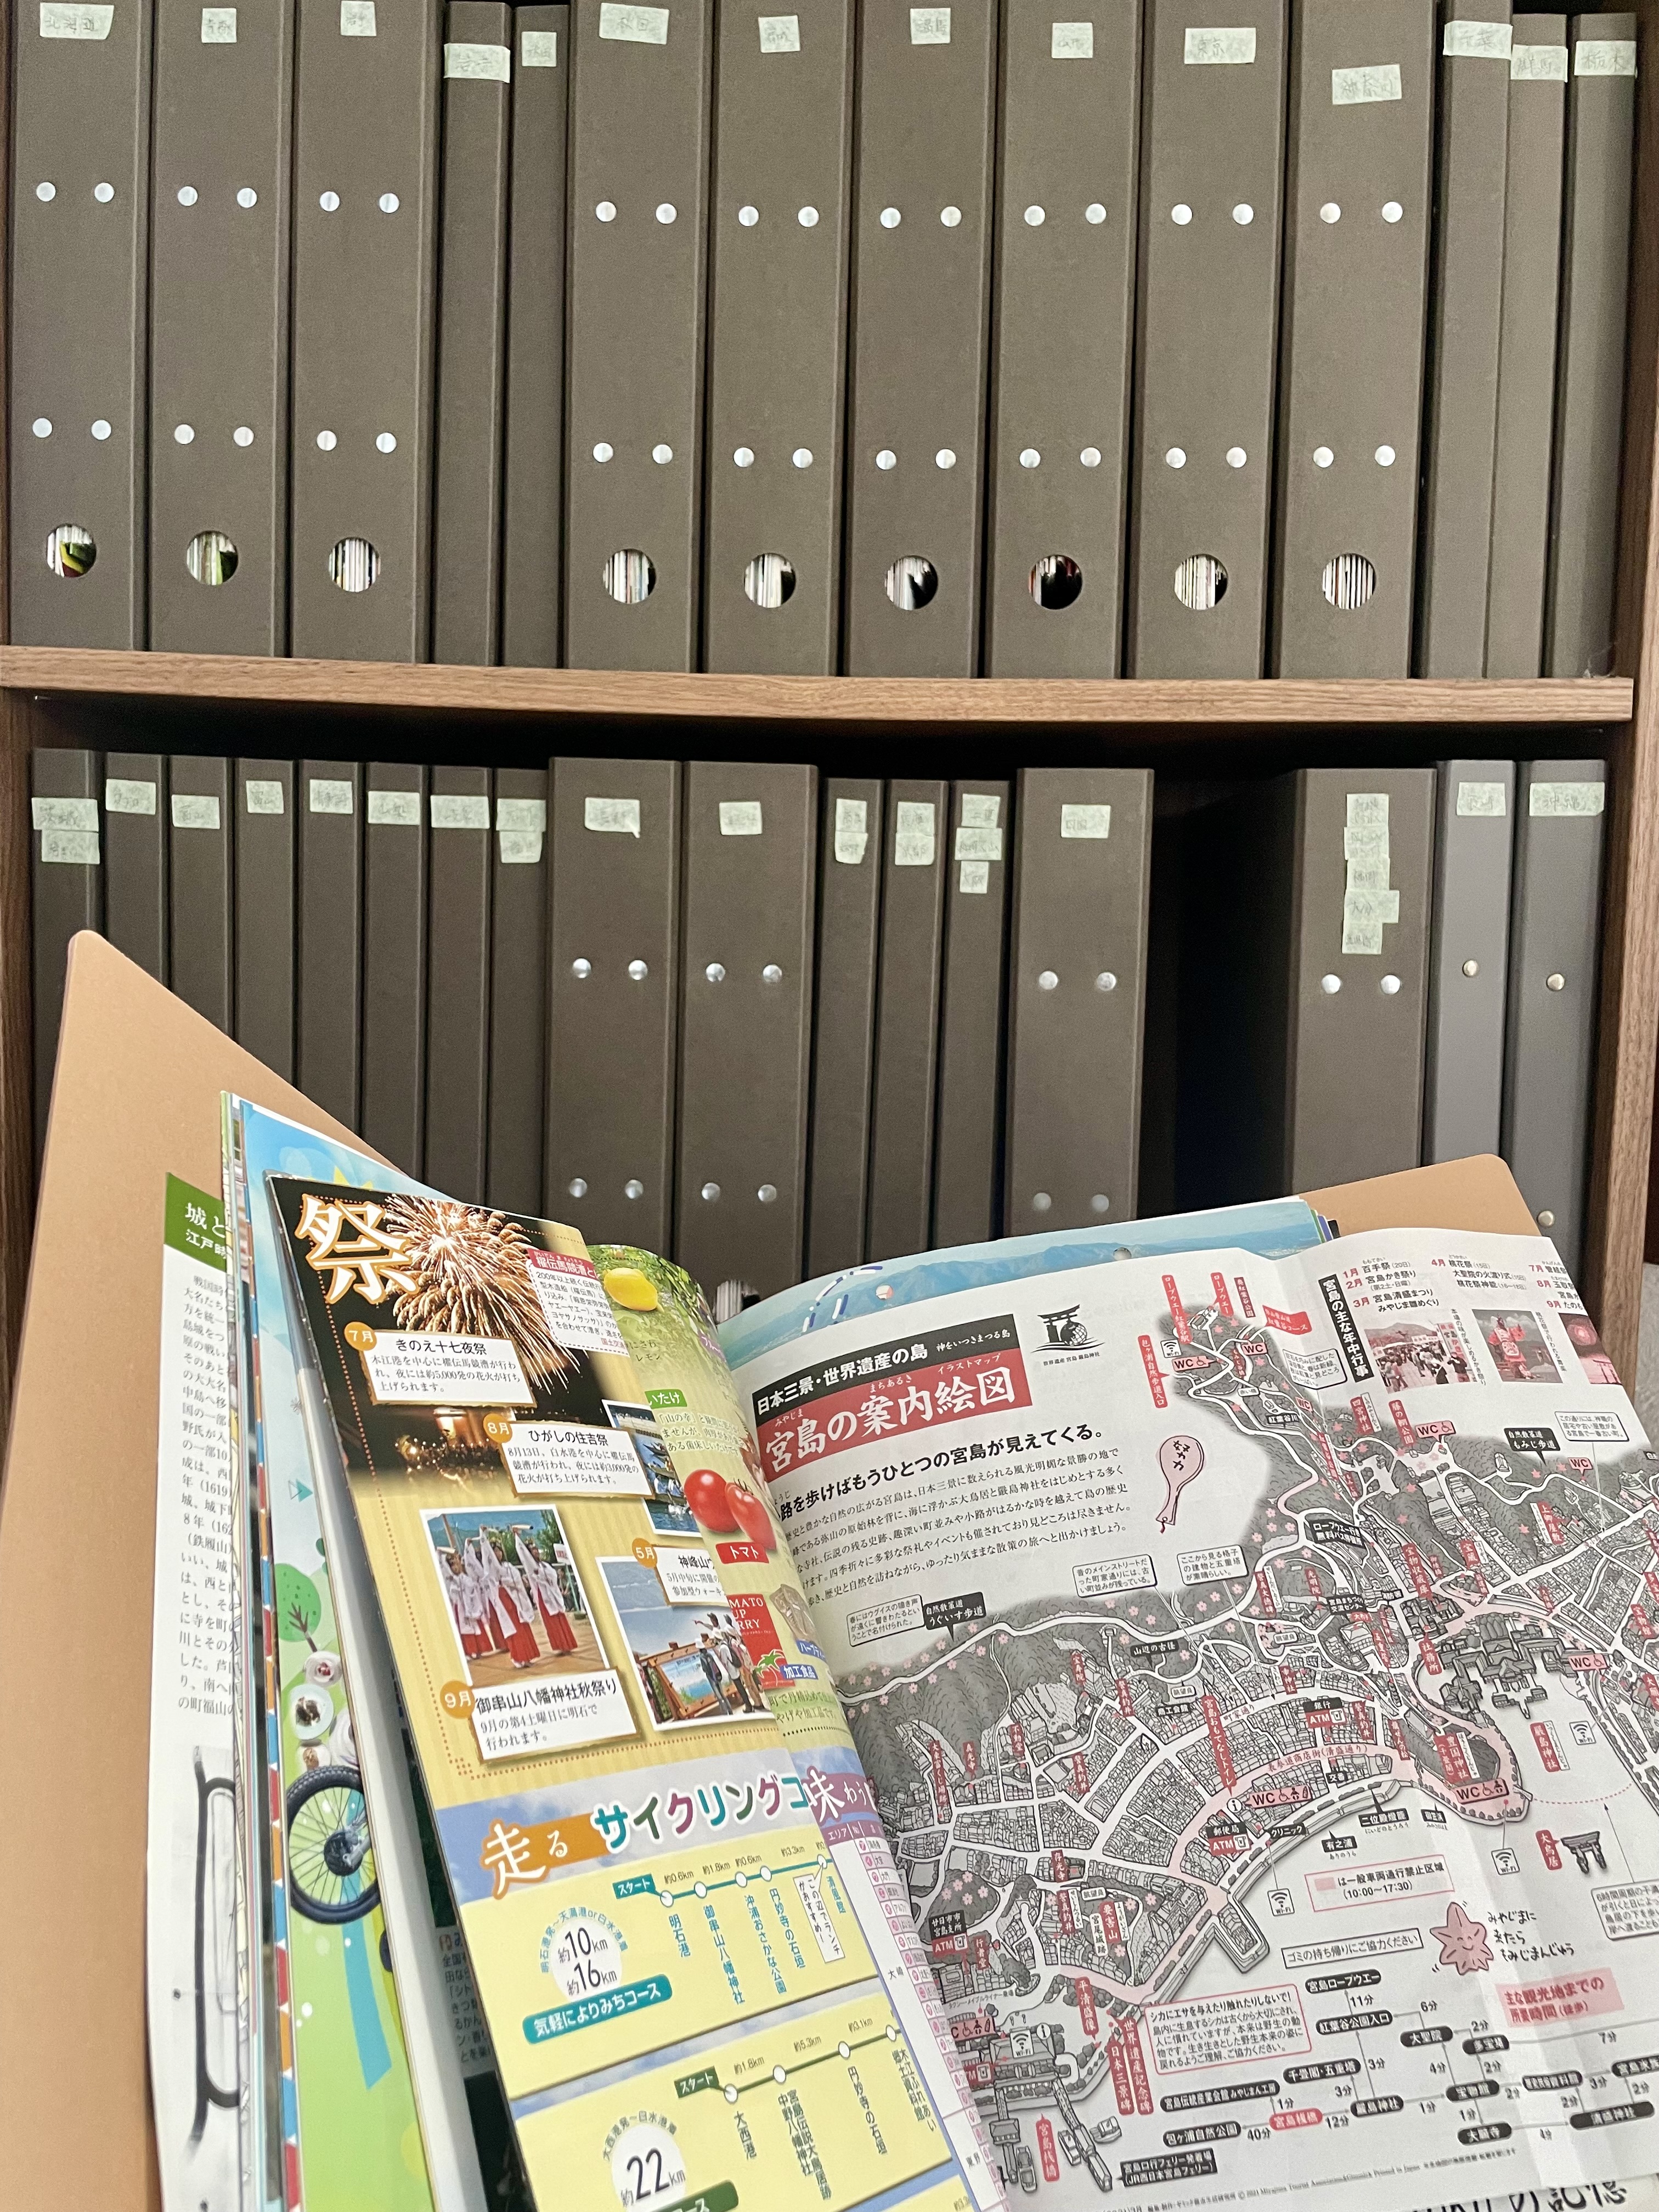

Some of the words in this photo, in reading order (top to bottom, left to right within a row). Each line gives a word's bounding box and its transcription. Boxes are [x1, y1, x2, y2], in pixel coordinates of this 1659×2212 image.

[1198, 38, 1225, 57] 東京
[295, 1193, 419, 1304] 祭
[1343, 1268, 1359, 1278] 1月
[1346, 1279, 1363, 1289] 2月
[1365, 1270, 1416, 1284] 宮島かき祭り
[1353, 1297, 1370, 1307] 3月
[1373, 1289, 1434, 1303] 宮島清盛まつり
[348, 1329, 375, 1343] 7月
[1322, 1278, 1372, 1379] 宮島の主な年中行事
[396, 1340, 487, 1355] きのえ十七夜祭
[936, 1328, 1011, 1353] 神をいつきまつる島
[1244, 1344, 1263, 1353] WC
[938, 1353, 1002, 1374] イラストマップ
[1175, 1358, 1194, 1369] WC
[380, 1381, 445, 1392] 上げられます。
[757, 1342, 928, 1414] 日本三景・世界遺産の島
[869, 1374, 913, 1393] まちあるき
[766, 1365, 1016, 1473] 宮島の案内絵図
[775, 1409, 804, 1427] みやじま
[488, 1423, 510, 1435] 8月
[529, 1429, 608, 1446] ひがしの住吉祭
[1418, 1425, 1439, 1435] WC
[1513, 1438, 1557, 1452] もみじ歩道
[1570, 1459, 1589, 1467] WC
[518, 1474, 618, 1485] 花火が打ち上げられます。
[636, 1546, 654, 1560] 5月
[731, 1545, 760, 1559] トマト
[1181, 1549, 1238, 1564] ここから見る格子
[1076, 1557, 1148, 1578] 昔のメインストリートだ
[1183, 1558, 1241, 1572] の建物と五重塔
[1186, 1569, 1232, 1581] が素晴らしい。
[849, 1598, 918, 1623] 春にはウグイスの鳴き声
[929, 1607, 984, 1626] うぐいす歩道
[851, 1606, 920, 1633] が遠くに響きわたるとい
[851, 1621, 913, 1641] うことで名付けられた。
[1421, 1642, 1440, 1672] 社務所
[1571, 1657, 1591, 1668] WC
[784, 1667, 816, 1679] 加工食品
[444, 1692, 471, 1707] 9月
[476, 1678, 617, 1715] 御串山八幡神社秋祭り
[1314, 1701, 1331, 1709] 銀行
[480, 1704, 597, 1734] 9月の第4土曜日に明石で
[1223, 1703, 1255, 1722] 町家通り
[1310, 1714, 1330, 1724] ATM
[486, 1732, 548, 1751] 行われます。
[1204, 1697, 1234, 1786] 宮島おもてなしトイレ
[1534, 1723, 1558, 1770] 厳島神社
[1446, 1736, 1469, 1779] 豊国神社
[1252, 1792, 1276, 1805] WC
[1457, 1786, 1481, 1799] WC
[827, 1827, 847, 1840] エリア
[1214, 1825, 1240, 1836] 郵便局
[1271, 1825, 1302, 1837] クリニック
[1213, 1840, 1233, 1850] ATM
[1540, 1833, 1559, 1867] 大鳥居
[483, 1822, 568, 1897] 走る
[736, 1854, 762, 1867] 約0.6km
[664, 1871, 694, 1884] 約0.6km
[1338, 1860, 1444, 1887] は一般車両通行禁止区域
[618, 1880, 650, 1895] スタート
[1104, 1904, 1118, 1940] 要害山
[1488, 1910, 1537, 1924] みやじまに
[669, 1914, 691, 1958] 明石港
[1092, 1915, 1106, 1954] 宮尾城跡
[1493, 1930, 1525, 1944] 来たら
[558, 1928, 608, 1963] 約10km
[745, 1894, 787, 1994] 沖浦おさかな公園
[935, 1941, 953, 1952] ATM
[1286, 1933, 1418, 1962] ゴミの持ち帰りにご協力ください
[1502, 1943, 1574, 1962] もみじまんじゅう
[704, 1905, 745, 2005] 御串山八幡神社
[567, 1960, 618, 1996] 約16km
[1307, 1972, 1379, 1993] 宮島ロープウエー
[1504, 1977, 1604, 2005] 主な観光地までの
[1077, 1980, 1096, 2031] 平清盛像
[1350, 1995, 1374, 2007] 11分
[1420, 2001, 1437, 2011] 6分
[534, 1984, 662, 2038] 気軽によりみちコース
[1156, 2017, 1301, 2046] 人に慣れていますが、本来は野生の動
[1471, 2021, 1489, 2032] 2分
[1157, 2029, 1304, 2058] 物です。生き生きとした野生本来の姿に
[1600, 2032, 1617, 2044] 7分
[1159, 2042, 1286, 2069] 戻れるようご理解、ご協力ください。
[1369, 2058, 1385, 2069] 3分
[1123, 2021, 1152, 2112] 世界遺産記念碑
[1430, 2062, 1446, 2074] 4分
[1485, 2061, 1502, 2073] 2分
[679, 2071, 714, 2095] スタート
[1110, 2047, 1132, 2111] 日本三景碑
[1335, 2085, 1352, 2097] 3分
[1277, 2098, 1294, 2109] 1分
[1420, 2102, 1436, 2114] 1分
[1561, 2096, 1578, 2108] 2分
[1325, 2116, 1350, 2128] 12分
[1460, 2108, 1476, 2121] 1分
[1247, 2128, 1272, 2141] 40分
[620, 2148, 686, 2207] 約22km
